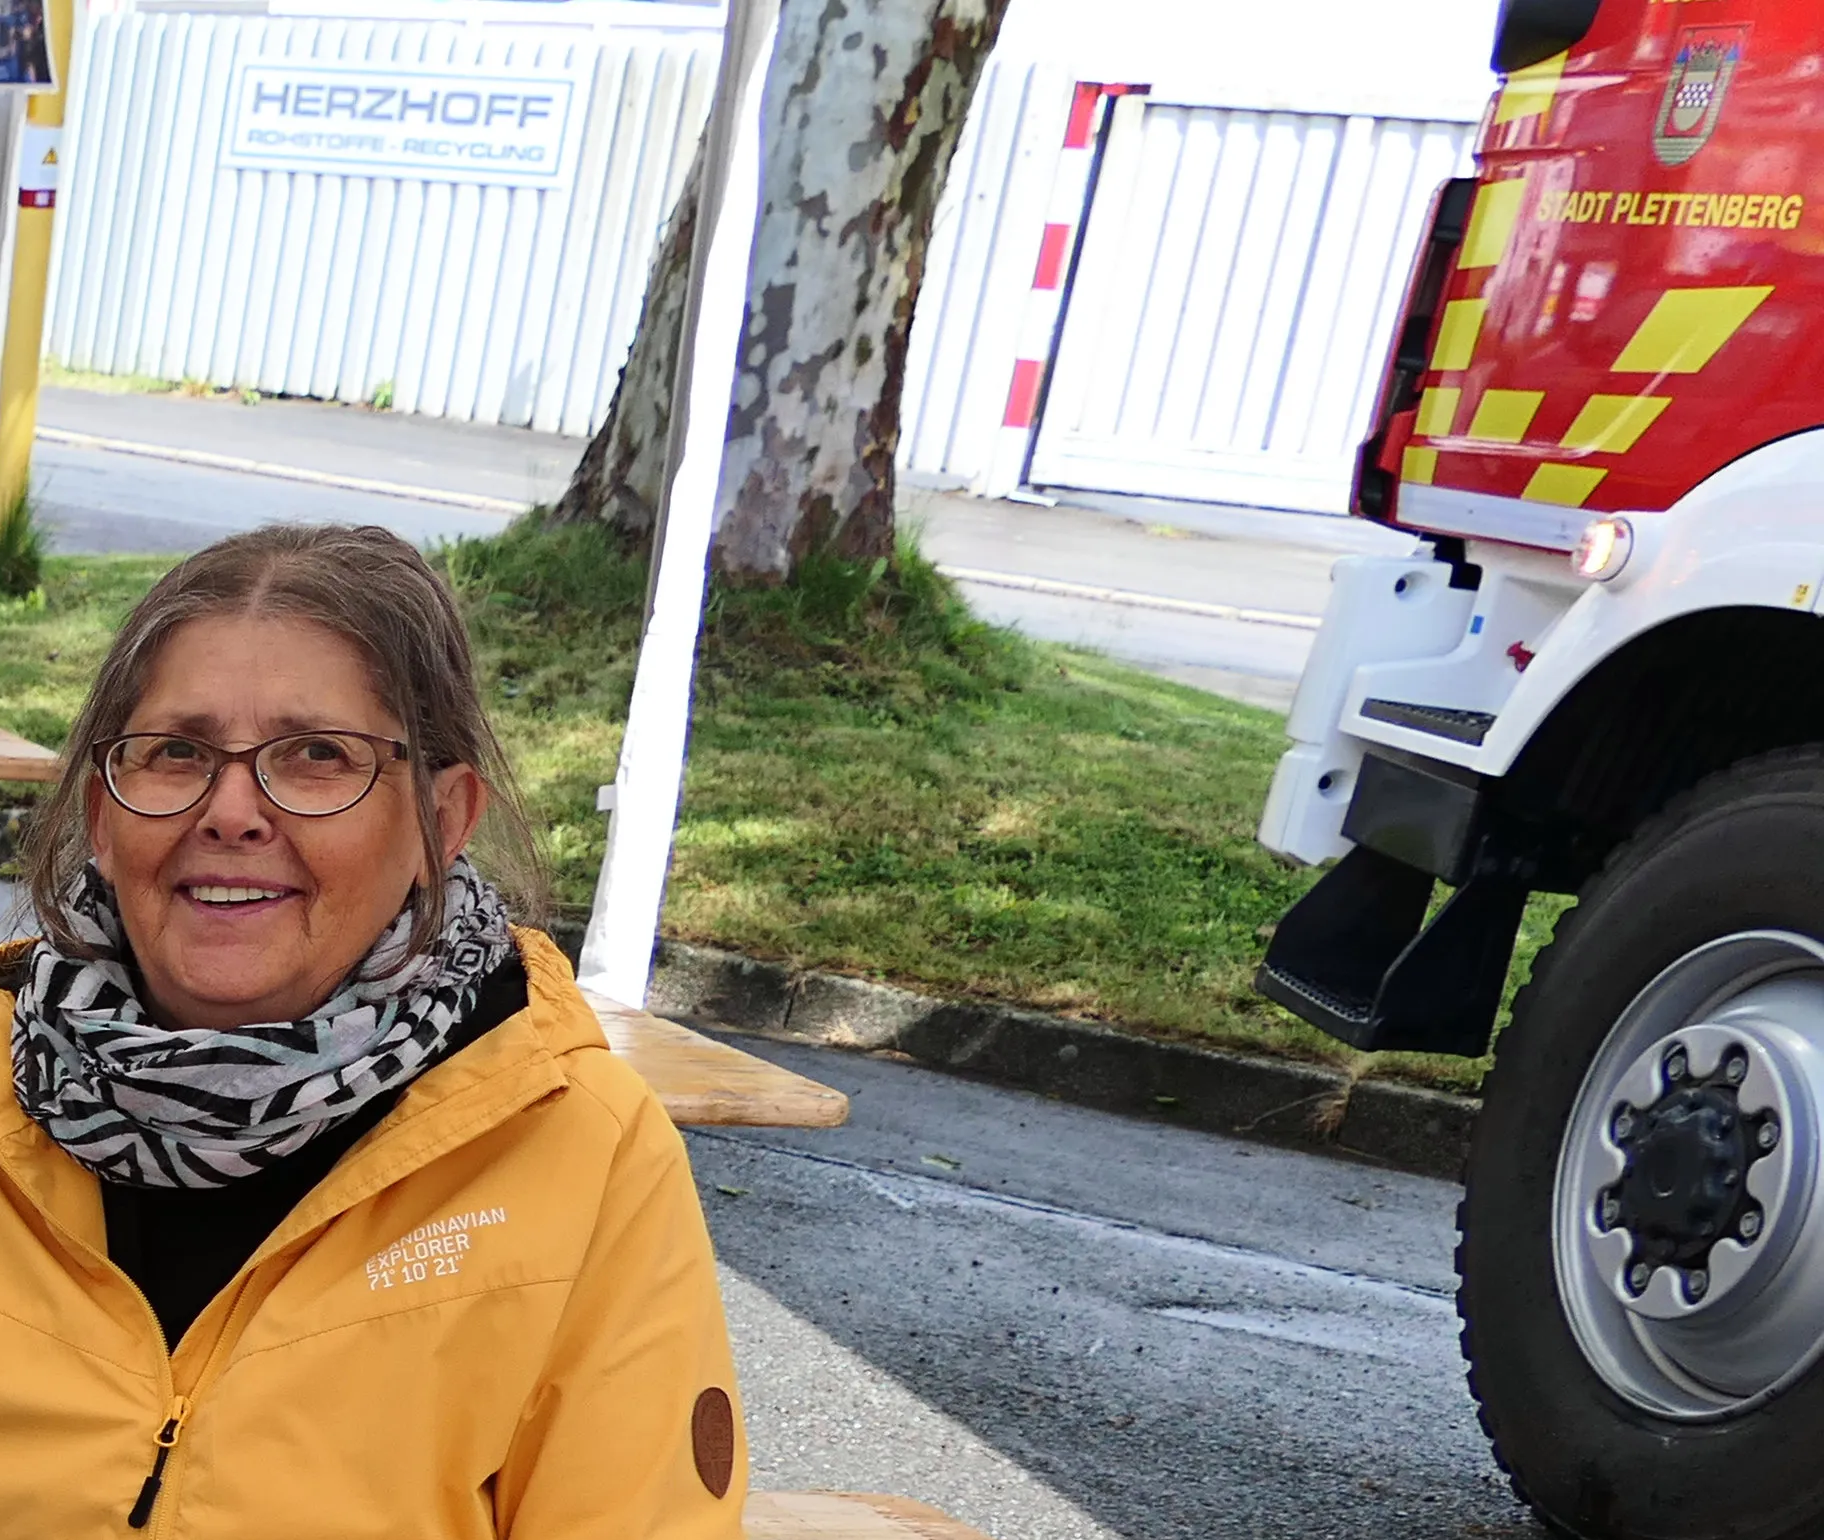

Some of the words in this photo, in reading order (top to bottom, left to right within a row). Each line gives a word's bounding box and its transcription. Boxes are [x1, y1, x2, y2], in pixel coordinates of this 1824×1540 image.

[252, 80, 554, 128] HERZHOFF
[247, 129, 386, 153] ROHSTOFFE
[401, 138, 547, 163] RECYCLING
[1536, 190, 1613, 224] STADT
[1610, 191, 1804, 231] PLETTENBERG
[365, 1233, 471, 1275] EXPLORER
[367, 1268, 396, 1291] 71°
